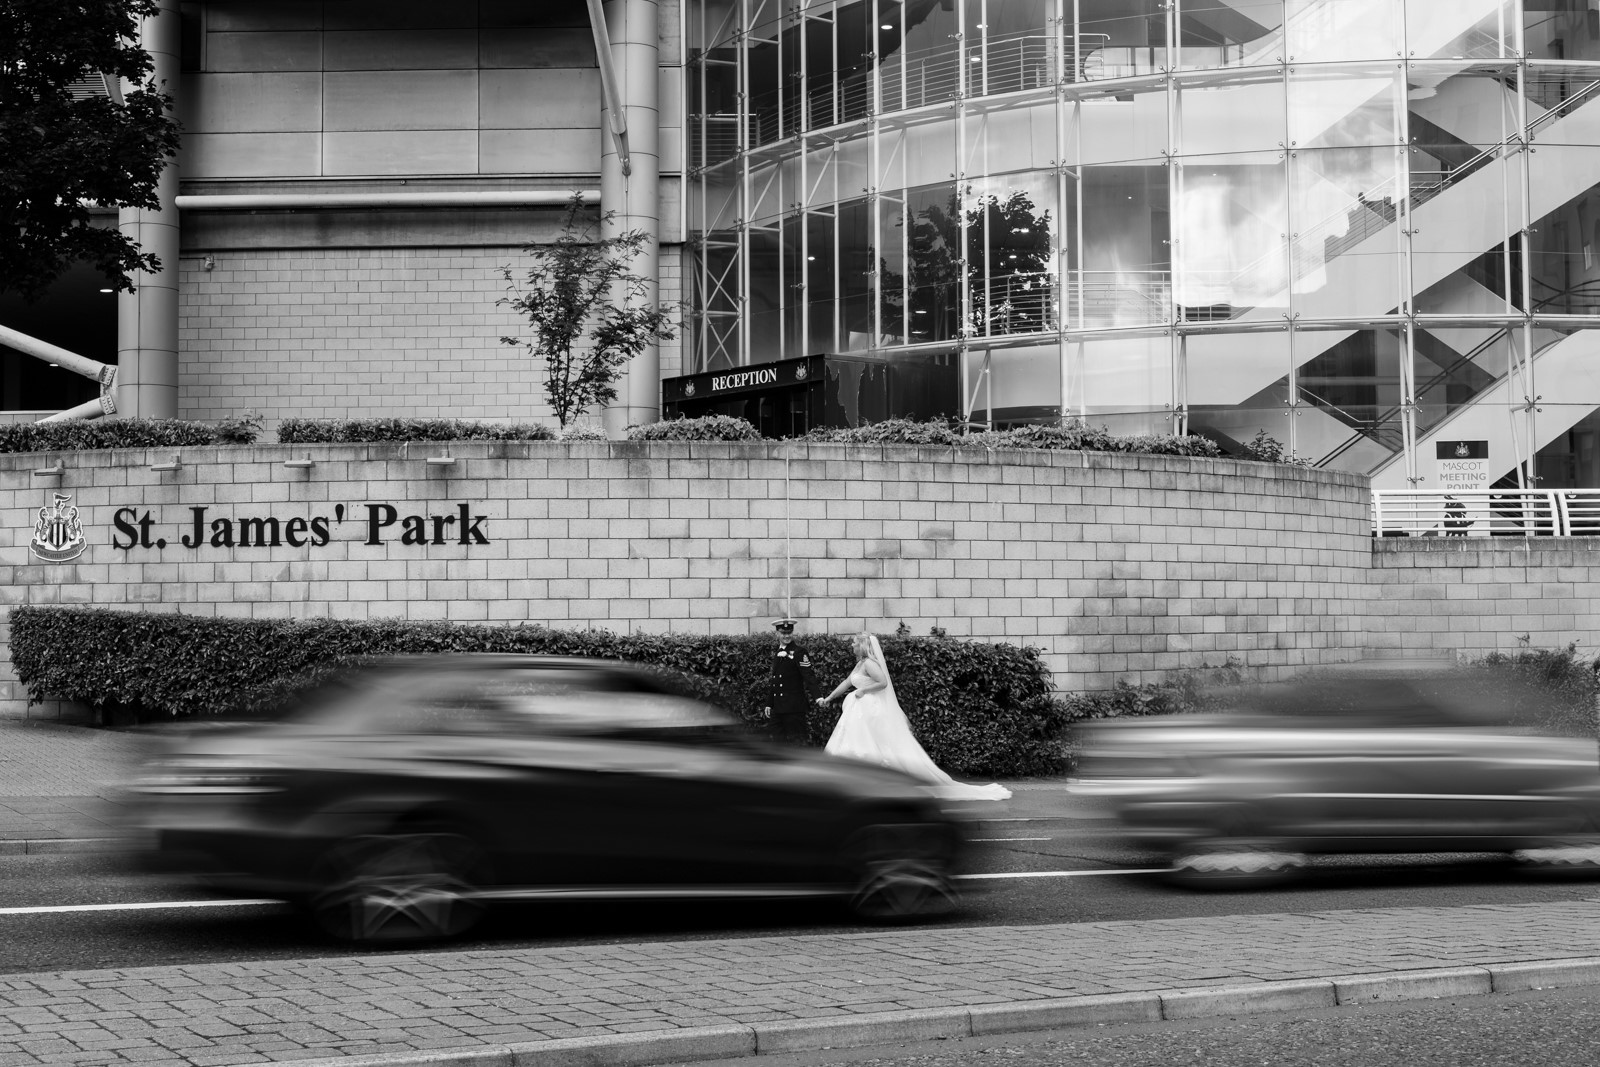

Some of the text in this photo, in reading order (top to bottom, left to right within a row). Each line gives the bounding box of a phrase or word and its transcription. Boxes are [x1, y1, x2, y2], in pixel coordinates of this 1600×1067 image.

[711, 368, 778, 391] RECEPTION
[1442, 461, 1483, 471] MASCOT
[1440, 472, 1487, 481] MEETING
[112, 503, 490, 551] St. James' Park
